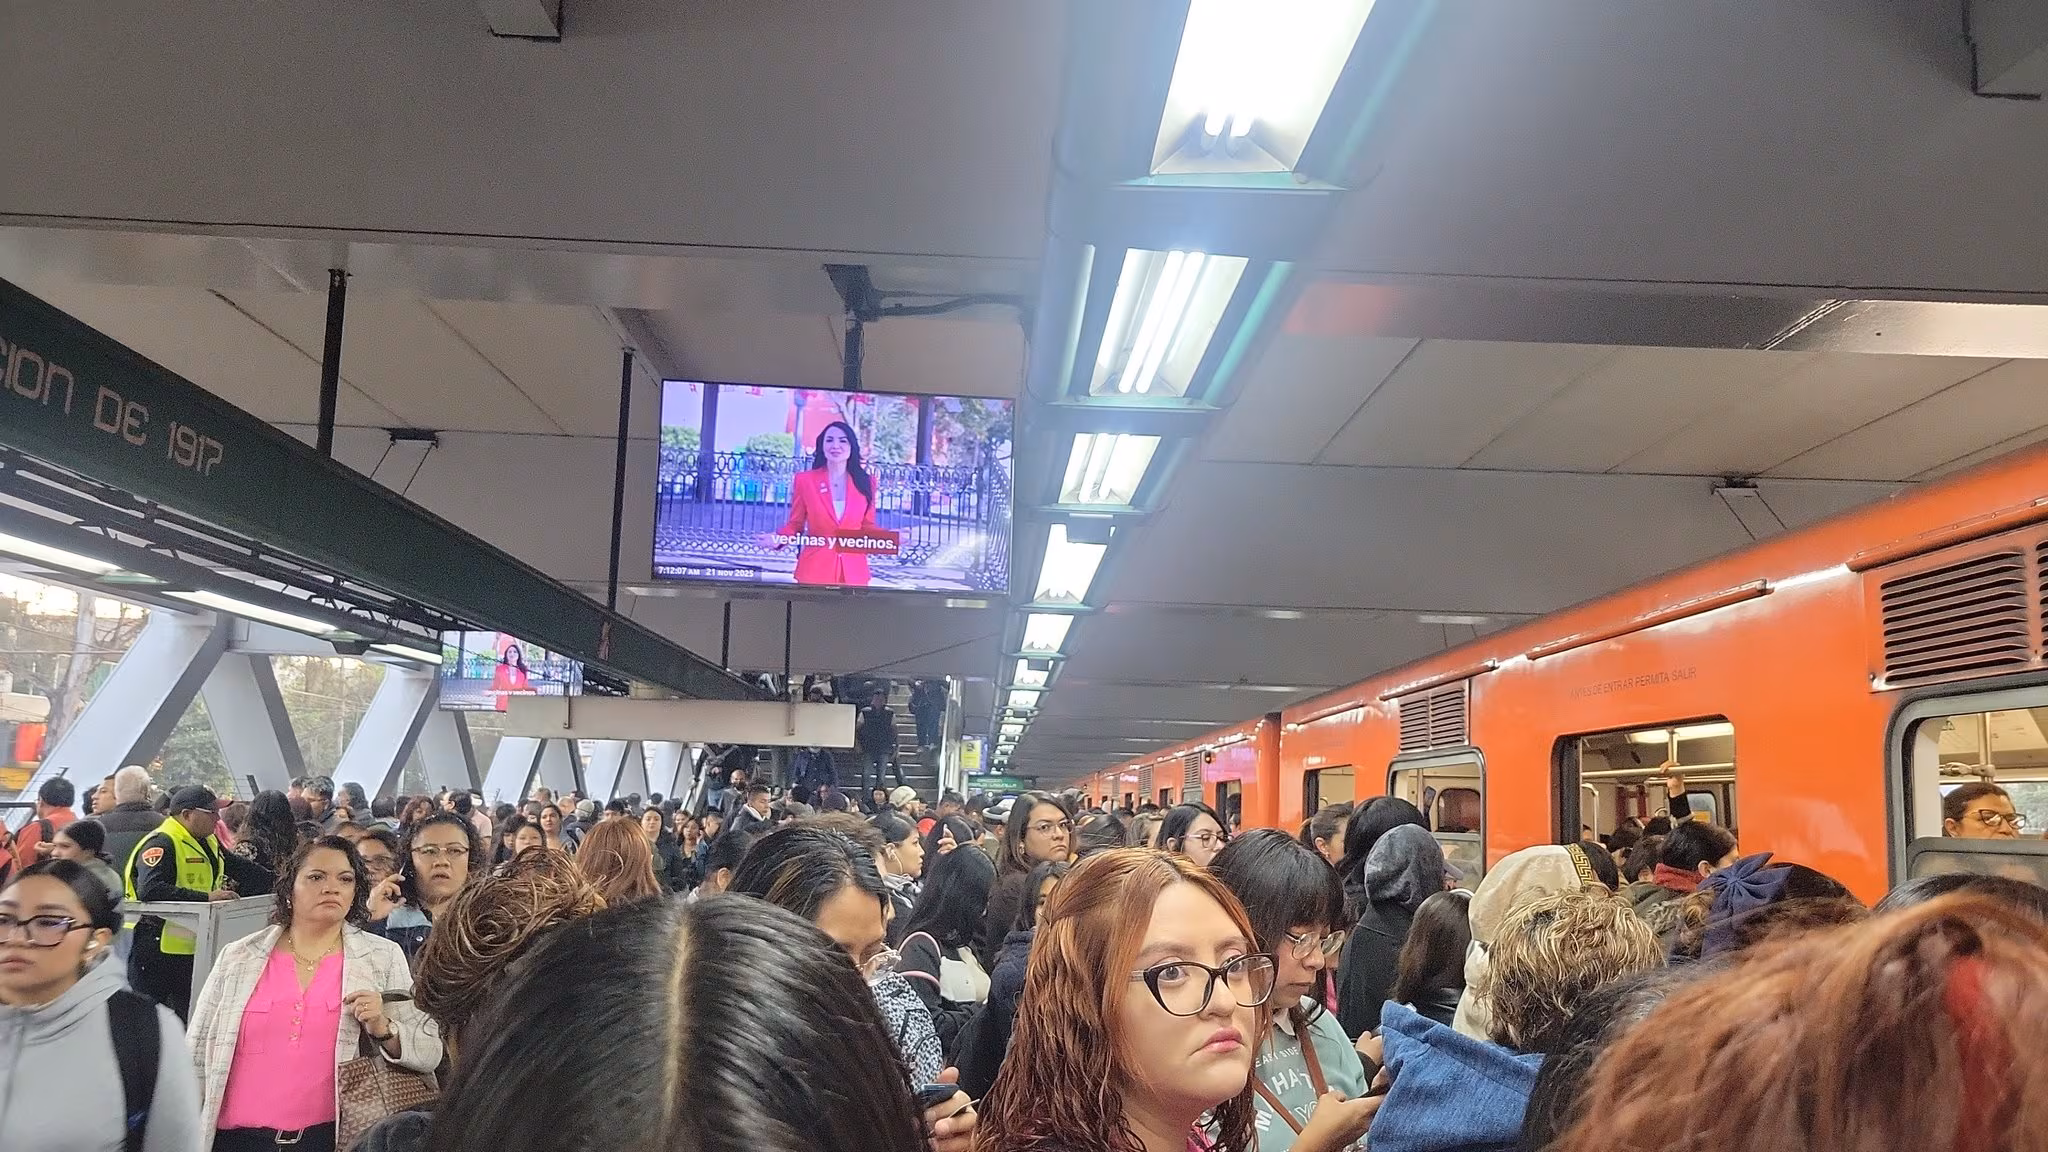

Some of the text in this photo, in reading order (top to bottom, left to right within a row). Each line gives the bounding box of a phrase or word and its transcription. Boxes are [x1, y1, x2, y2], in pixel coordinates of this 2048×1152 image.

[0, 336, 224, 476] ION DE 1917
[772, 533, 897, 549] vecinas y vecinos.
[658, 566, 687, 575] 7:12:07
[706, 568, 716, 576] 21
[1592, 682, 1602, 695] DE
[1604, 678, 1634, 693] ENTRAR
[1635, 672, 1670, 687] PERMITA
[1671, 666, 1697, 681] SALIR
[1280, 1046, 1299, 1058] SIDE
